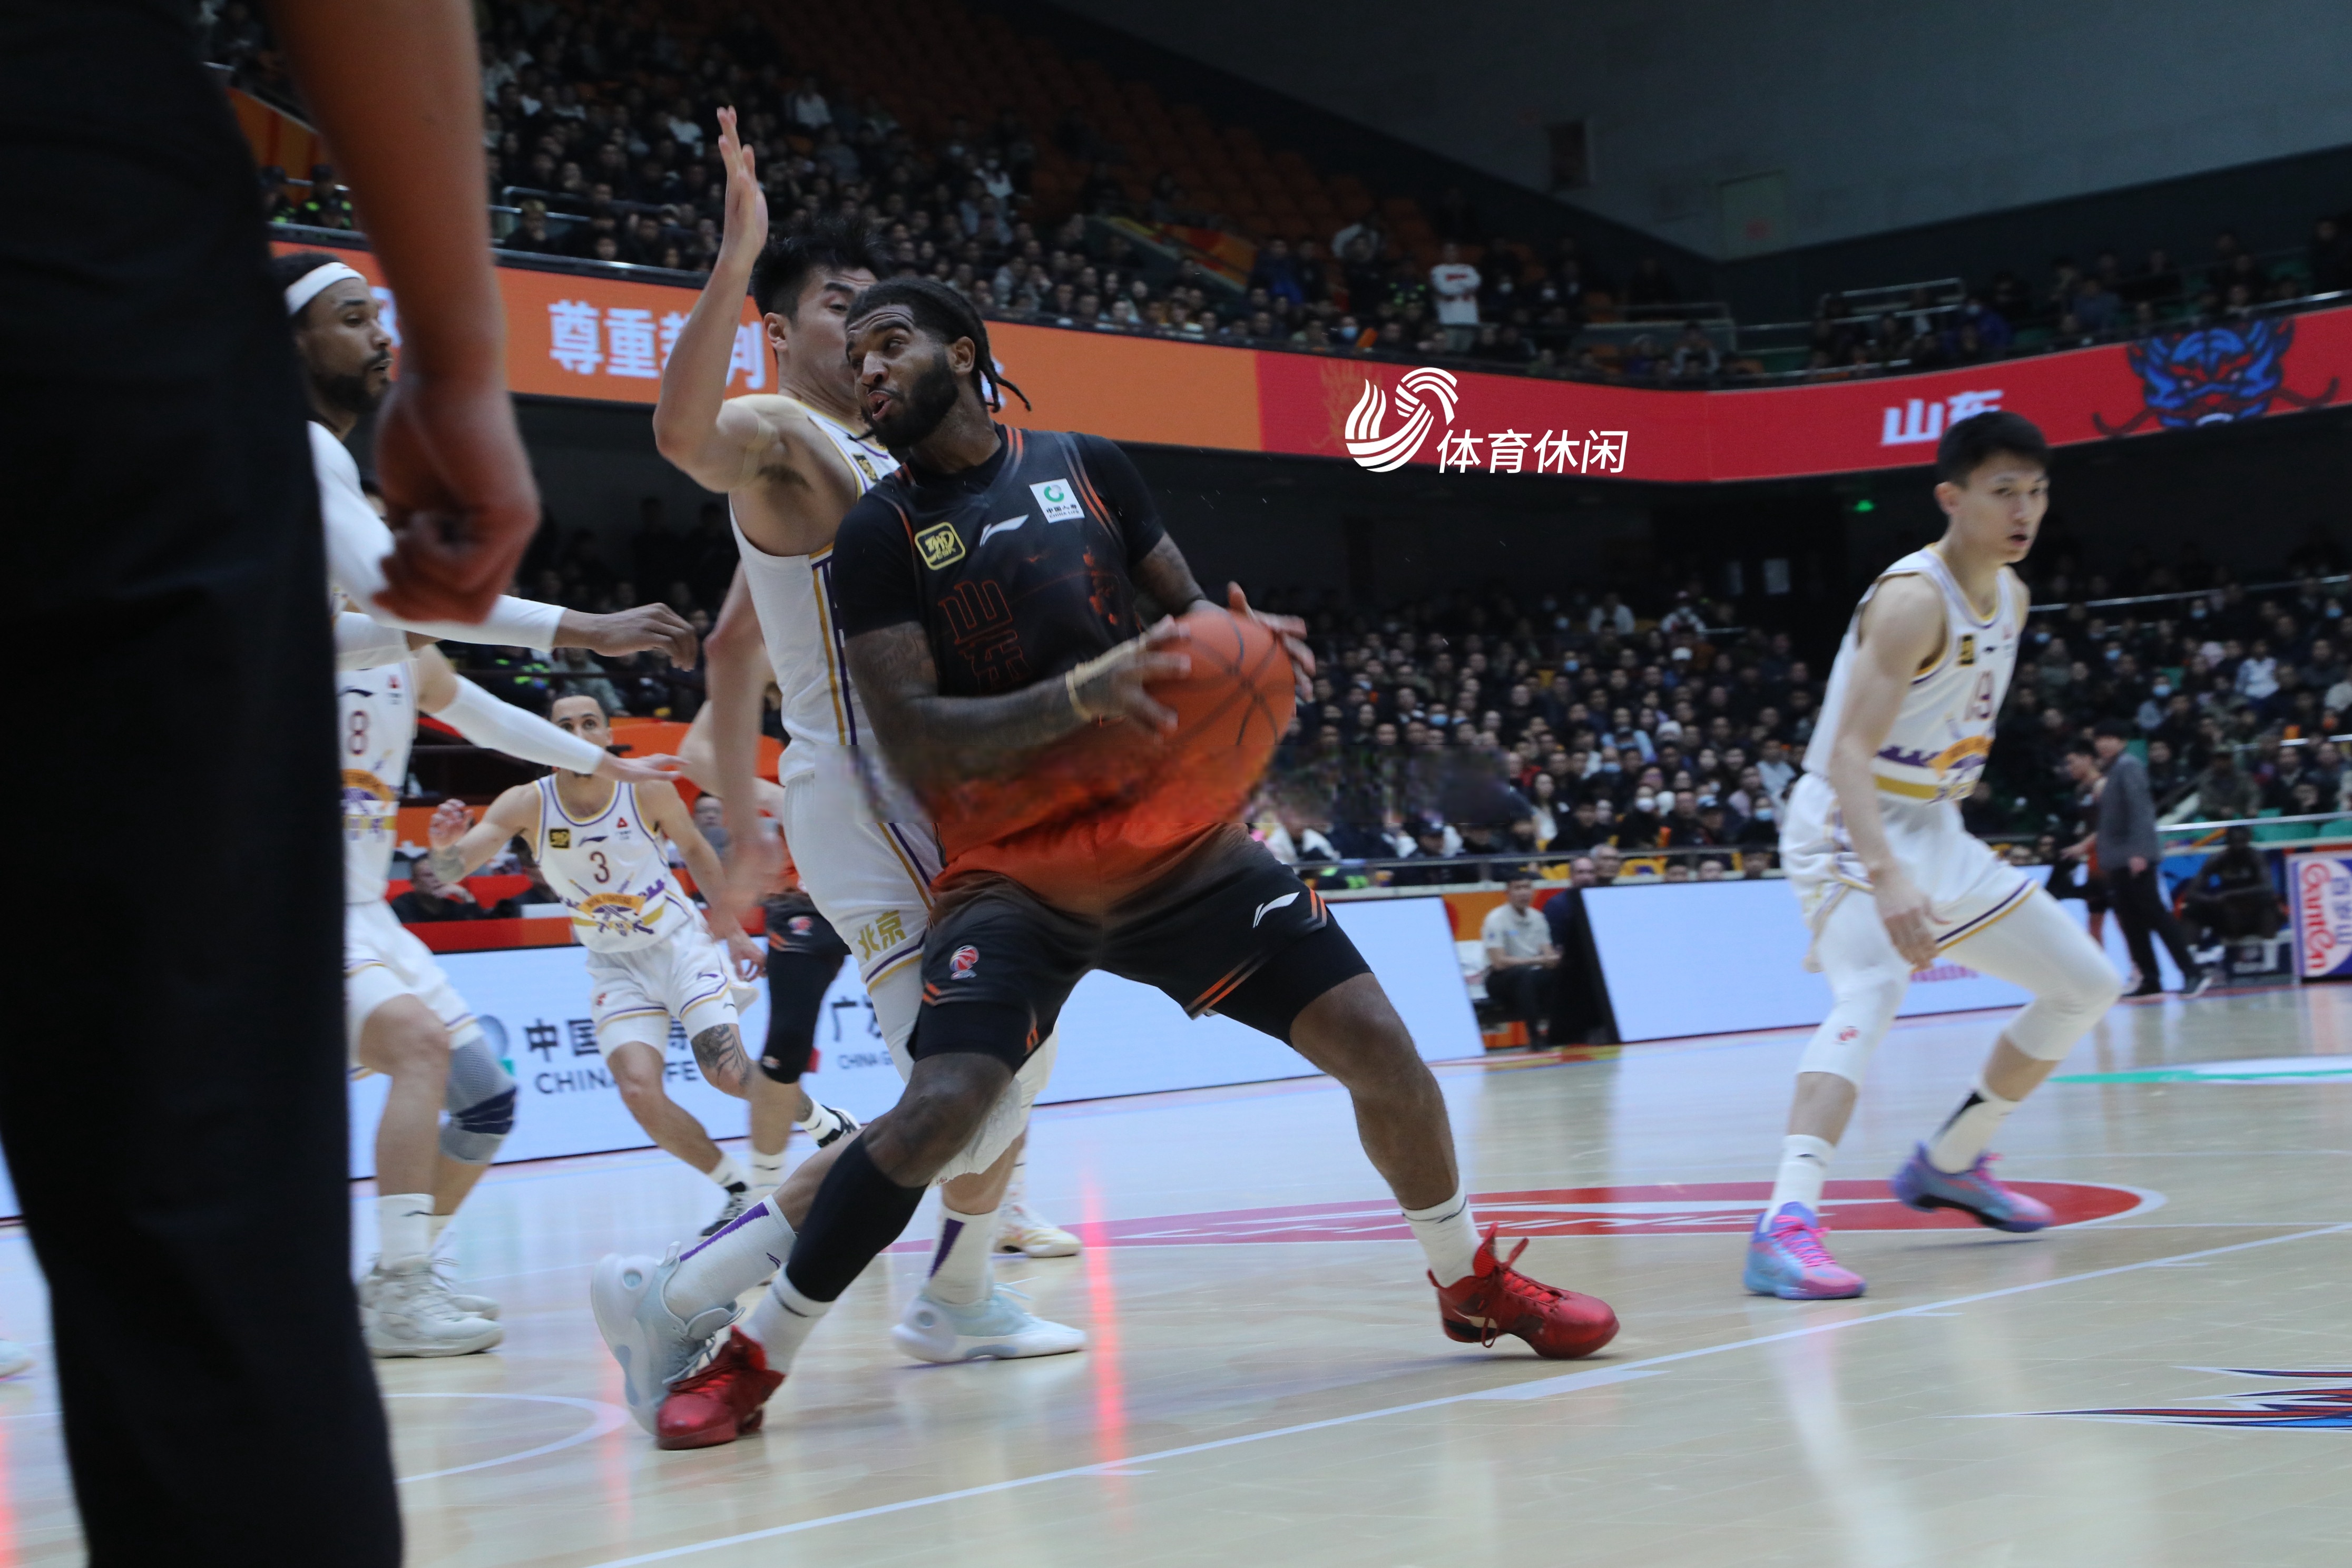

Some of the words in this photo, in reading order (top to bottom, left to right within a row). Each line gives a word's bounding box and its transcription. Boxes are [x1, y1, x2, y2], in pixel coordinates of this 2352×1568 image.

[348, 710, 369, 755] 8
[590, 851, 610, 884] 3
[857, 910, 907, 961] 北京
